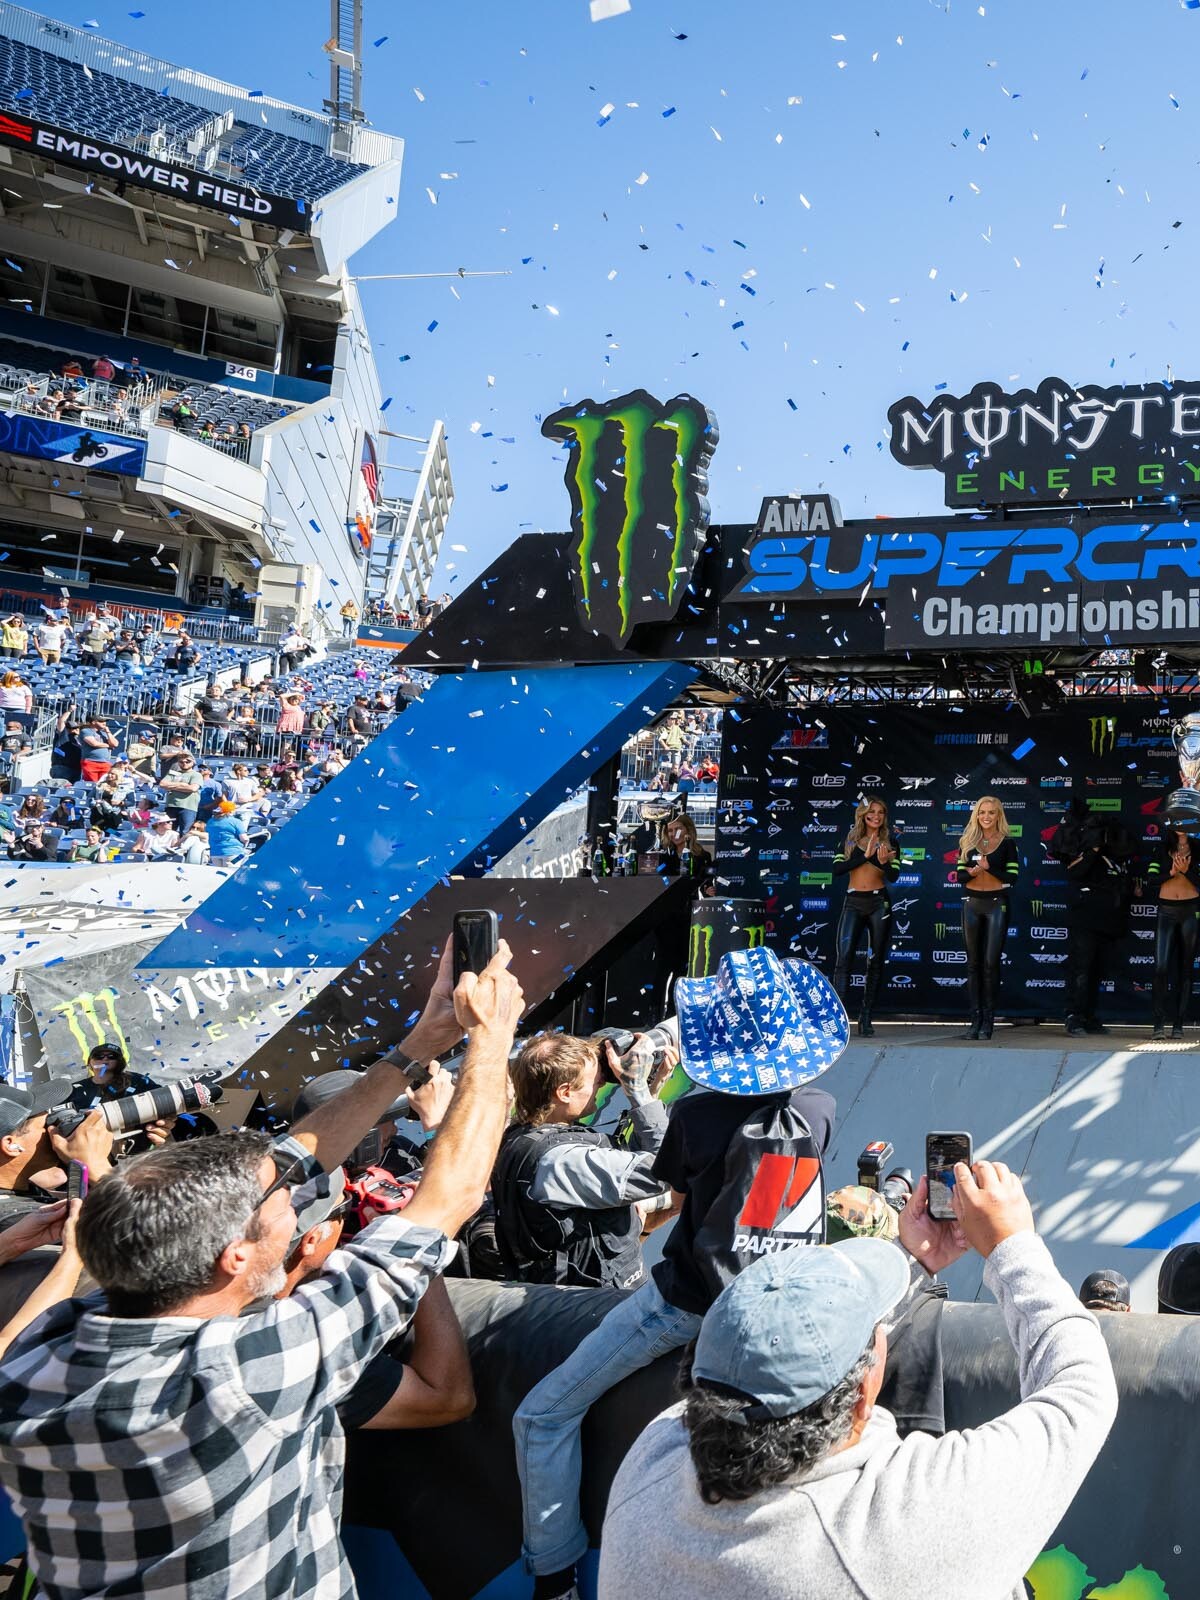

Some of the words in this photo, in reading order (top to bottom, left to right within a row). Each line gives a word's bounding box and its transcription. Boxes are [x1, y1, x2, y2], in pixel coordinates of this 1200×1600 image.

[43, 22, 70, 40] 541
[290, 110, 314, 126] 542
[36, 128, 190, 193] EMPOWER
[196, 181, 273, 216] FIELD
[228, 363, 255, 380] 346
[763, 499, 832, 534] AMA
[934, 733, 1009, 745] SUPERCROSSLIVE.COM
[1147, 750, 1178, 758] Champio
[812, 775, 846, 787] WPS
[1030, 926, 1069, 940] WPS
[932, 950, 968, 964] WPS
